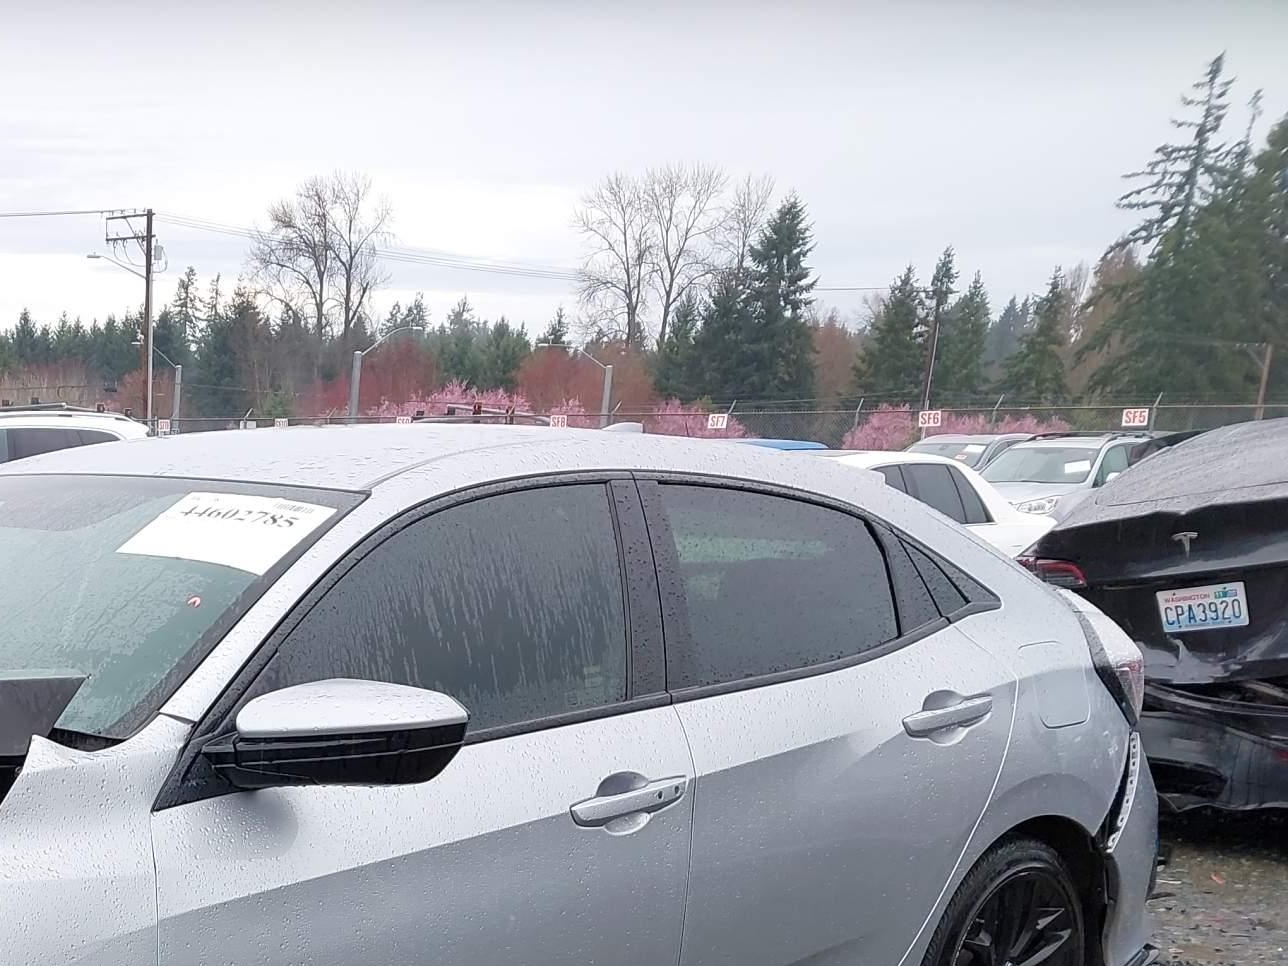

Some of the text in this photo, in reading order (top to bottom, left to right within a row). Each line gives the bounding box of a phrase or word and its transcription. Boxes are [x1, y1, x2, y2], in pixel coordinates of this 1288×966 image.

[551, 416, 566, 427] SF8
[710, 415, 726, 427] SF7
[920, 412, 940, 425] SF6
[1124, 410, 1147, 424] SF5
[180, 505, 299, 528] 44602785
[1164, 598, 1242, 626] CPA3920
